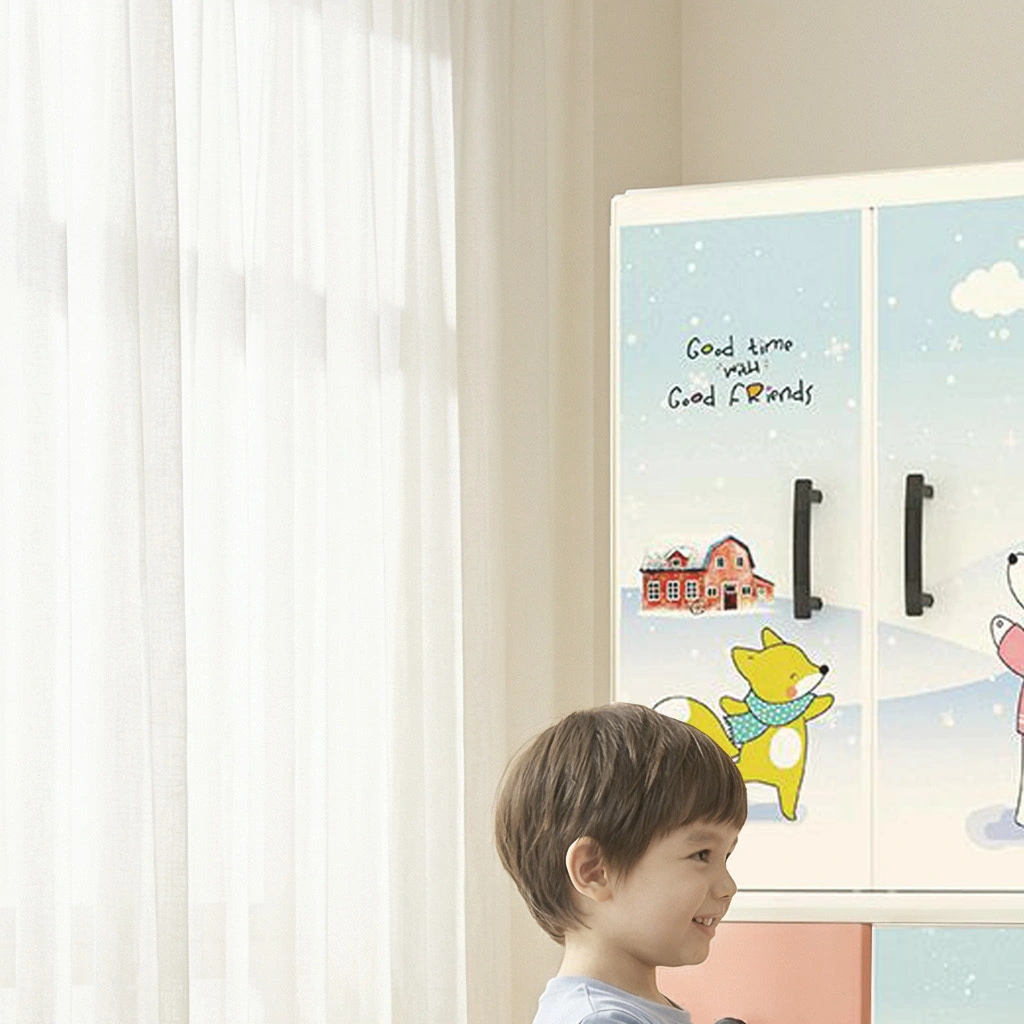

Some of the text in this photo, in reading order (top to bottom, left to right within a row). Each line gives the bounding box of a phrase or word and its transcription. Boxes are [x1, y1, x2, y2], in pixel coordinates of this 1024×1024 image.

[687, 336, 793, 360] Good time
[668, 385, 715, 409] Good
